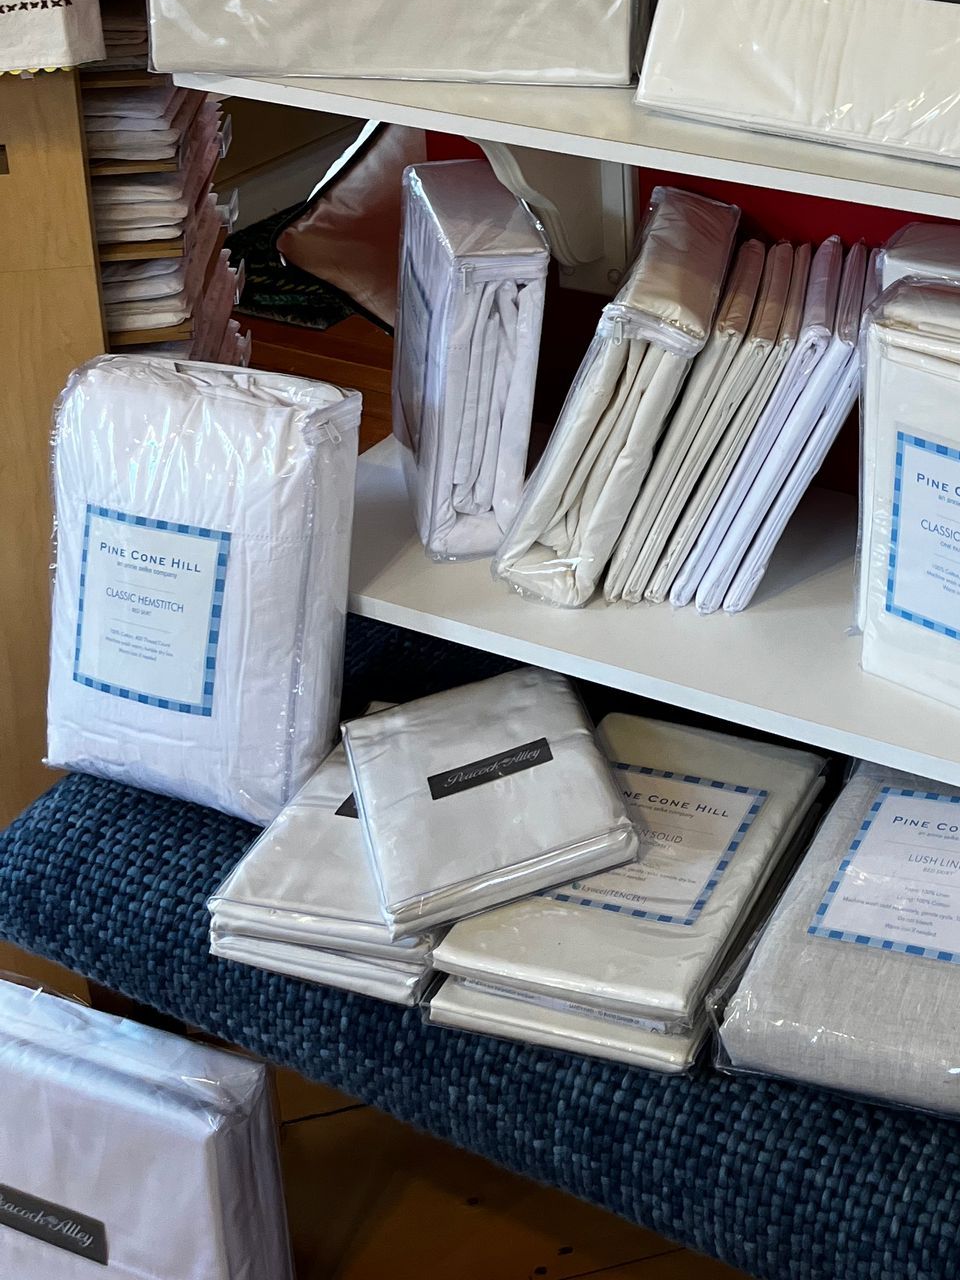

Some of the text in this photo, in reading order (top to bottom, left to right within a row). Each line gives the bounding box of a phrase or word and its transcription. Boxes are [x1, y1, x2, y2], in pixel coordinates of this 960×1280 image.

[916, 473, 949, 493] PINE
[921, 519, 960, 542] CLASSIC
[940, 541, 951, 549] ONE
[100, 542, 201, 573] PINE CONE HILL
[106, 586, 184, 613] CLASSIC HEMSTITCH
[444, 748, 540, 787] Peacock Alley
[623, 790, 729, 818] NE CONE HILL
[893, 816, 930, 829] PINE
[650, 832, 683, 844] SOLID
[908, 854, 939, 867] LUSH
[49, 1219, 94, 1247] Alley
